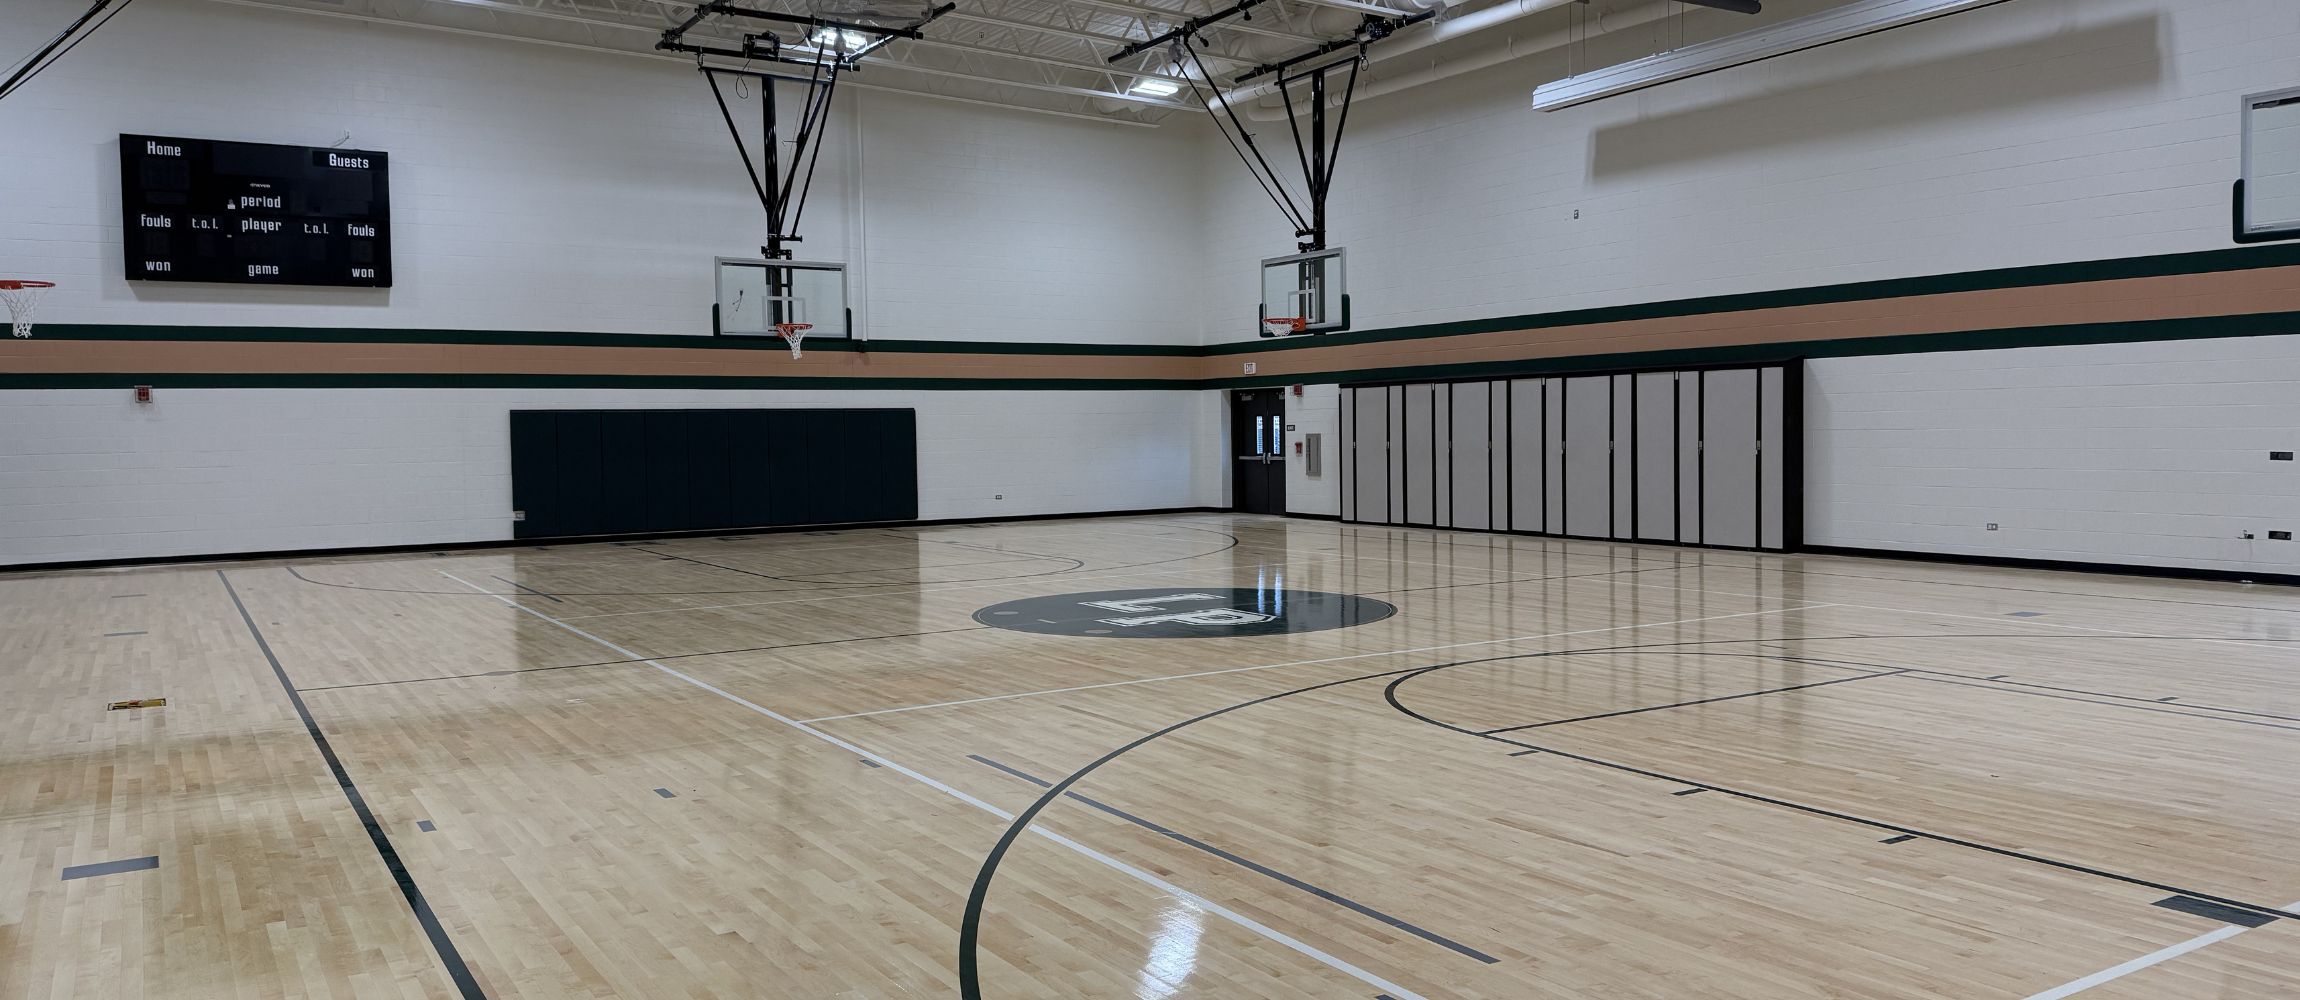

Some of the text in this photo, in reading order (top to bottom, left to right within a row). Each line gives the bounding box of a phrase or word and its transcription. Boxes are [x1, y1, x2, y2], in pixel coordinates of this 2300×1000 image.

[147, 141, 181, 156] Home
[329, 153, 369, 168] Guests
[241, 196, 280, 208] period
[141, 214, 171, 227] fouls
[242, 218, 281, 233] player
[348, 224, 374, 236] fouls
[146, 260, 171, 271] won
[248, 264, 279, 276] game
[352, 267, 375, 278] won
